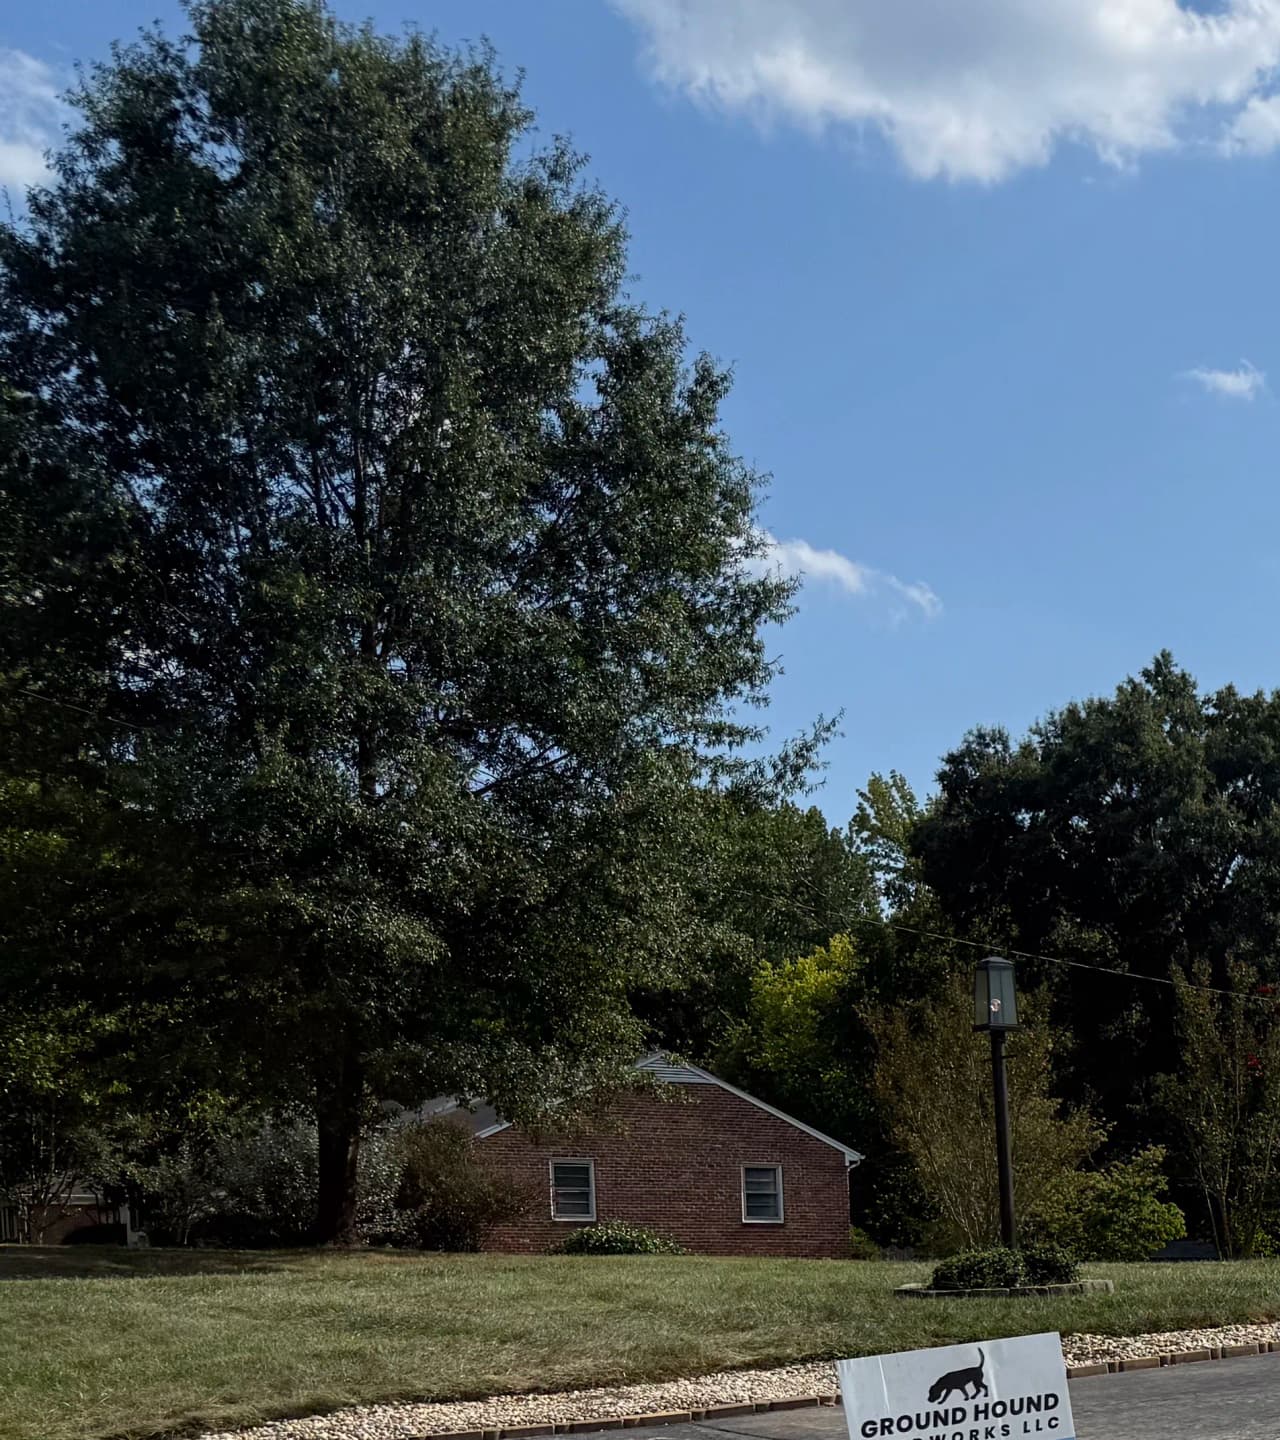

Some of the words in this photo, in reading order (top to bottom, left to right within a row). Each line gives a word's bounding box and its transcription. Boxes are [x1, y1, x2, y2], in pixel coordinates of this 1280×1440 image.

[861, 1407, 967, 1439] GROUND
[973, 1393, 1059, 1422] HOUND
[1023, 1417, 1060, 1434] LLC
